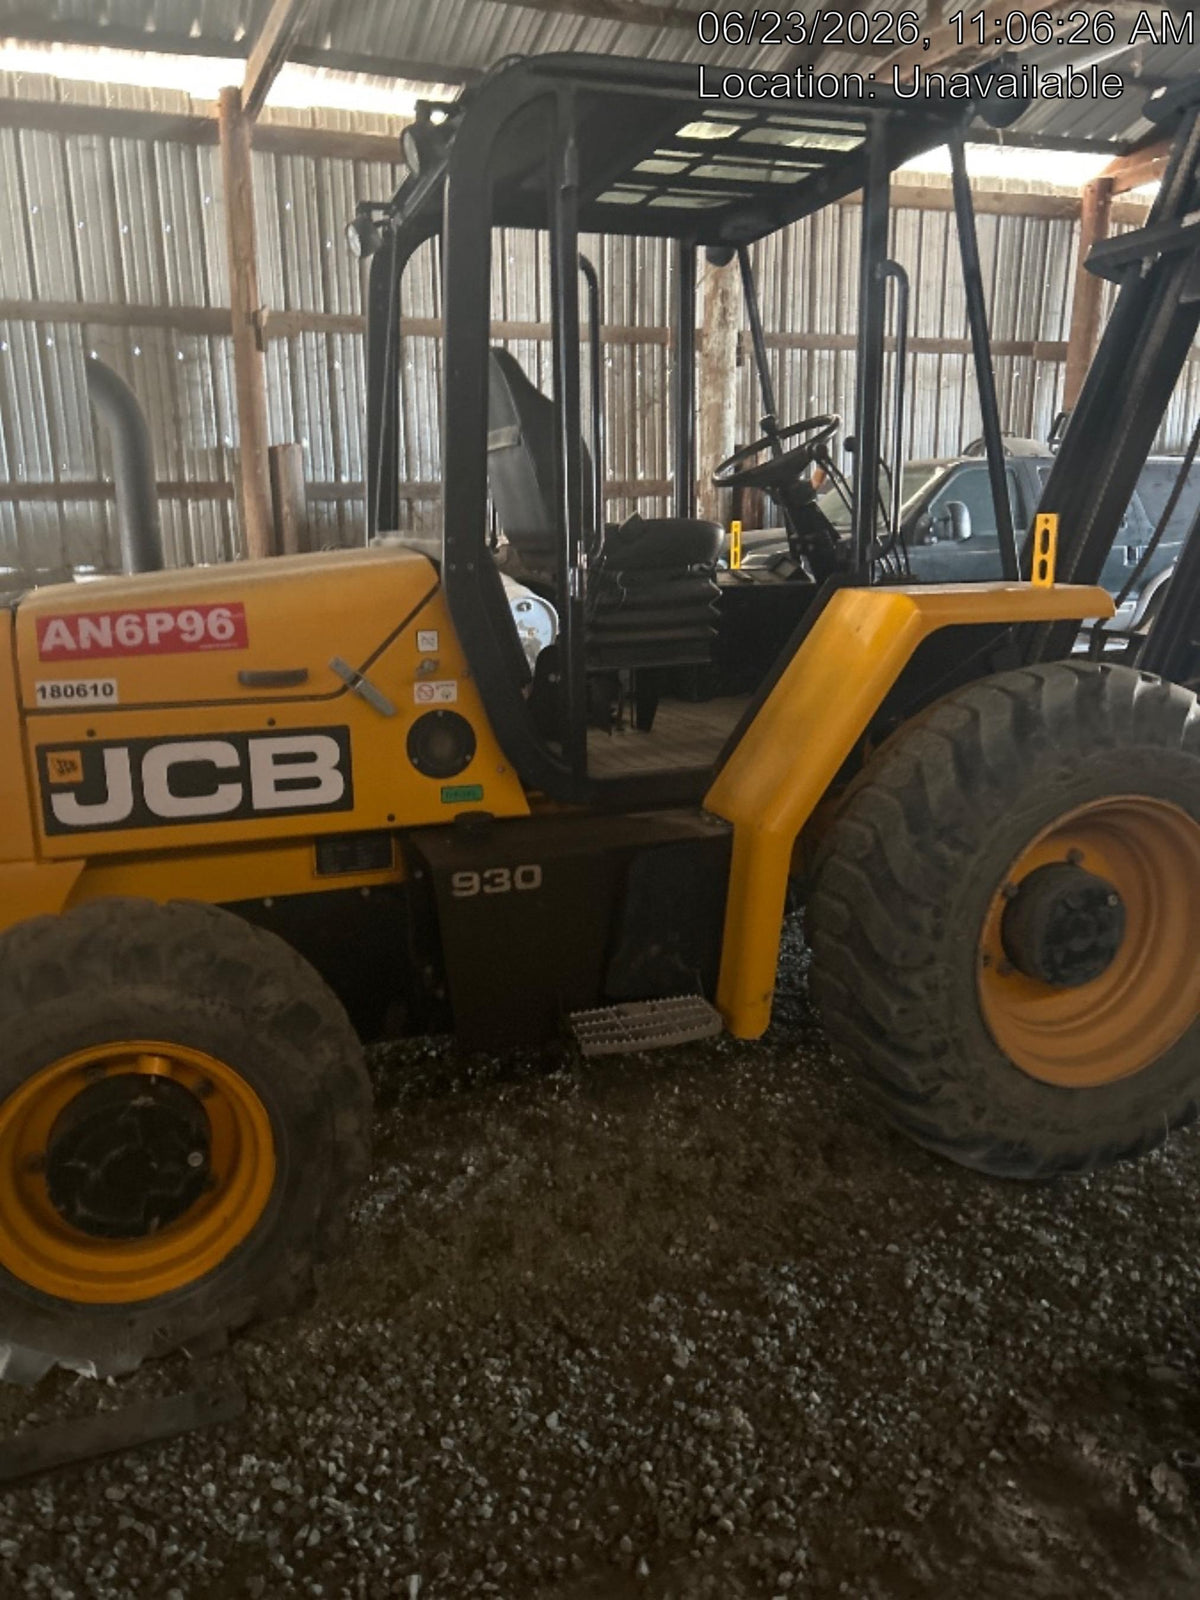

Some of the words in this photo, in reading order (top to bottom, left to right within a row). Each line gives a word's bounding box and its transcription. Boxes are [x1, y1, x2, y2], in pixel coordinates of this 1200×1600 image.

[41, 607, 236, 653] AN6P96
[37, 682, 115, 700] 180610
[51, 734, 345, 827] JCB
[451, 864, 543, 897] 930
